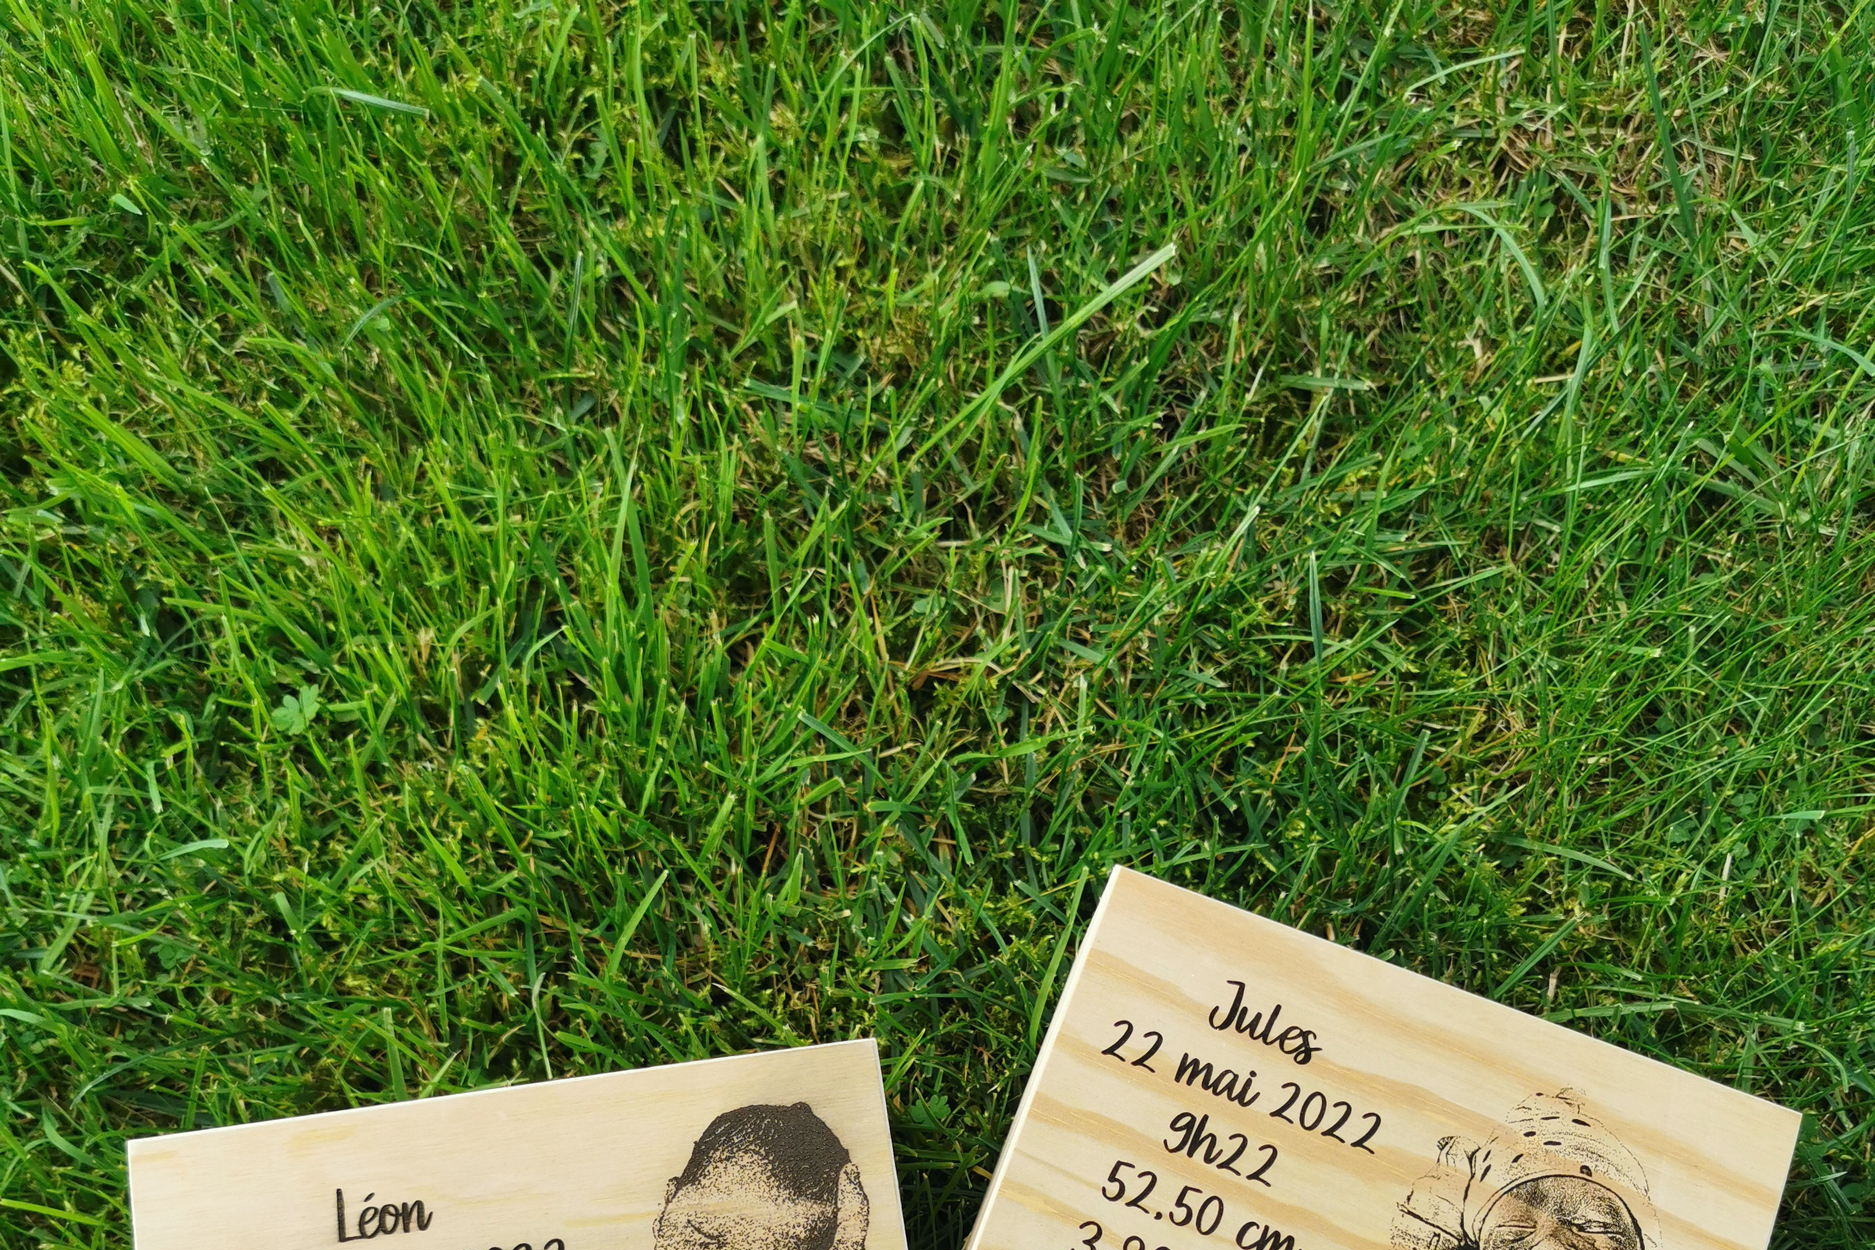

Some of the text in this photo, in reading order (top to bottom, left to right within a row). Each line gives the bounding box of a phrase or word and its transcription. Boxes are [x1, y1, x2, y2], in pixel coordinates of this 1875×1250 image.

[1208, 980, 1323, 1066] Jules
[1100, 1019, 1382, 1155] 22 mai 2022
[1163, 1111, 1278, 1188] 9h22
[336, 1188, 433, 1243] Léon
[1101, 1160, 1224, 1236] 52.50
